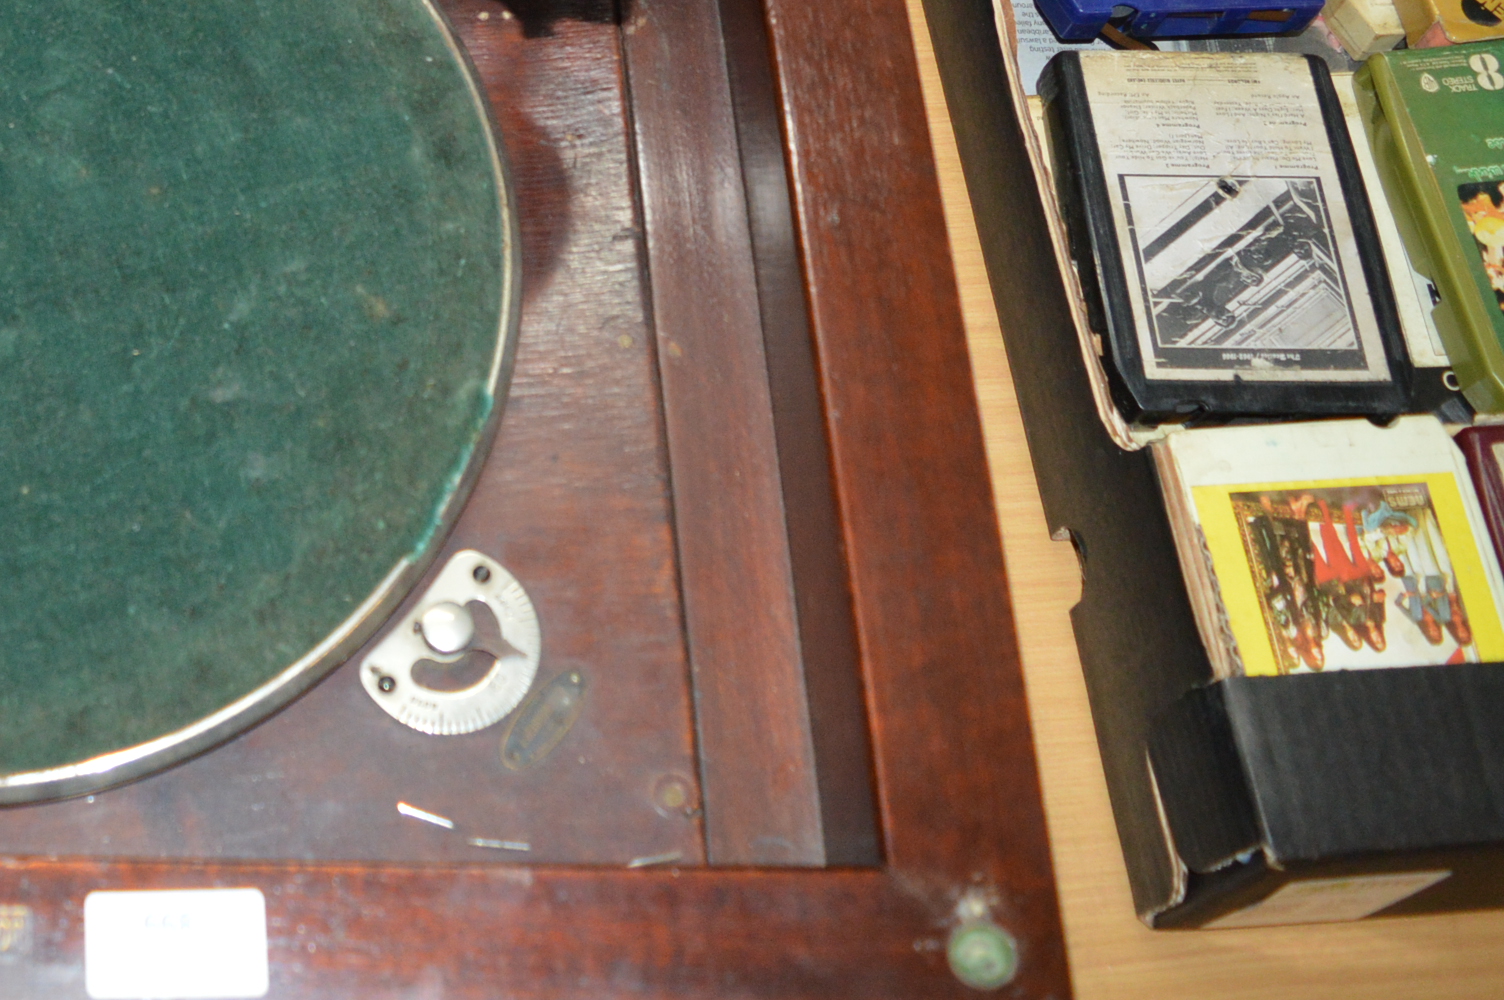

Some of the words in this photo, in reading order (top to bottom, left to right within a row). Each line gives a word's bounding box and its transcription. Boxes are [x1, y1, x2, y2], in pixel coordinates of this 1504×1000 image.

[1469, 53, 1504, 91] 8
[1442, 76, 1474, 85] STEREO
[1448, 84, 1478, 93] TRACK
